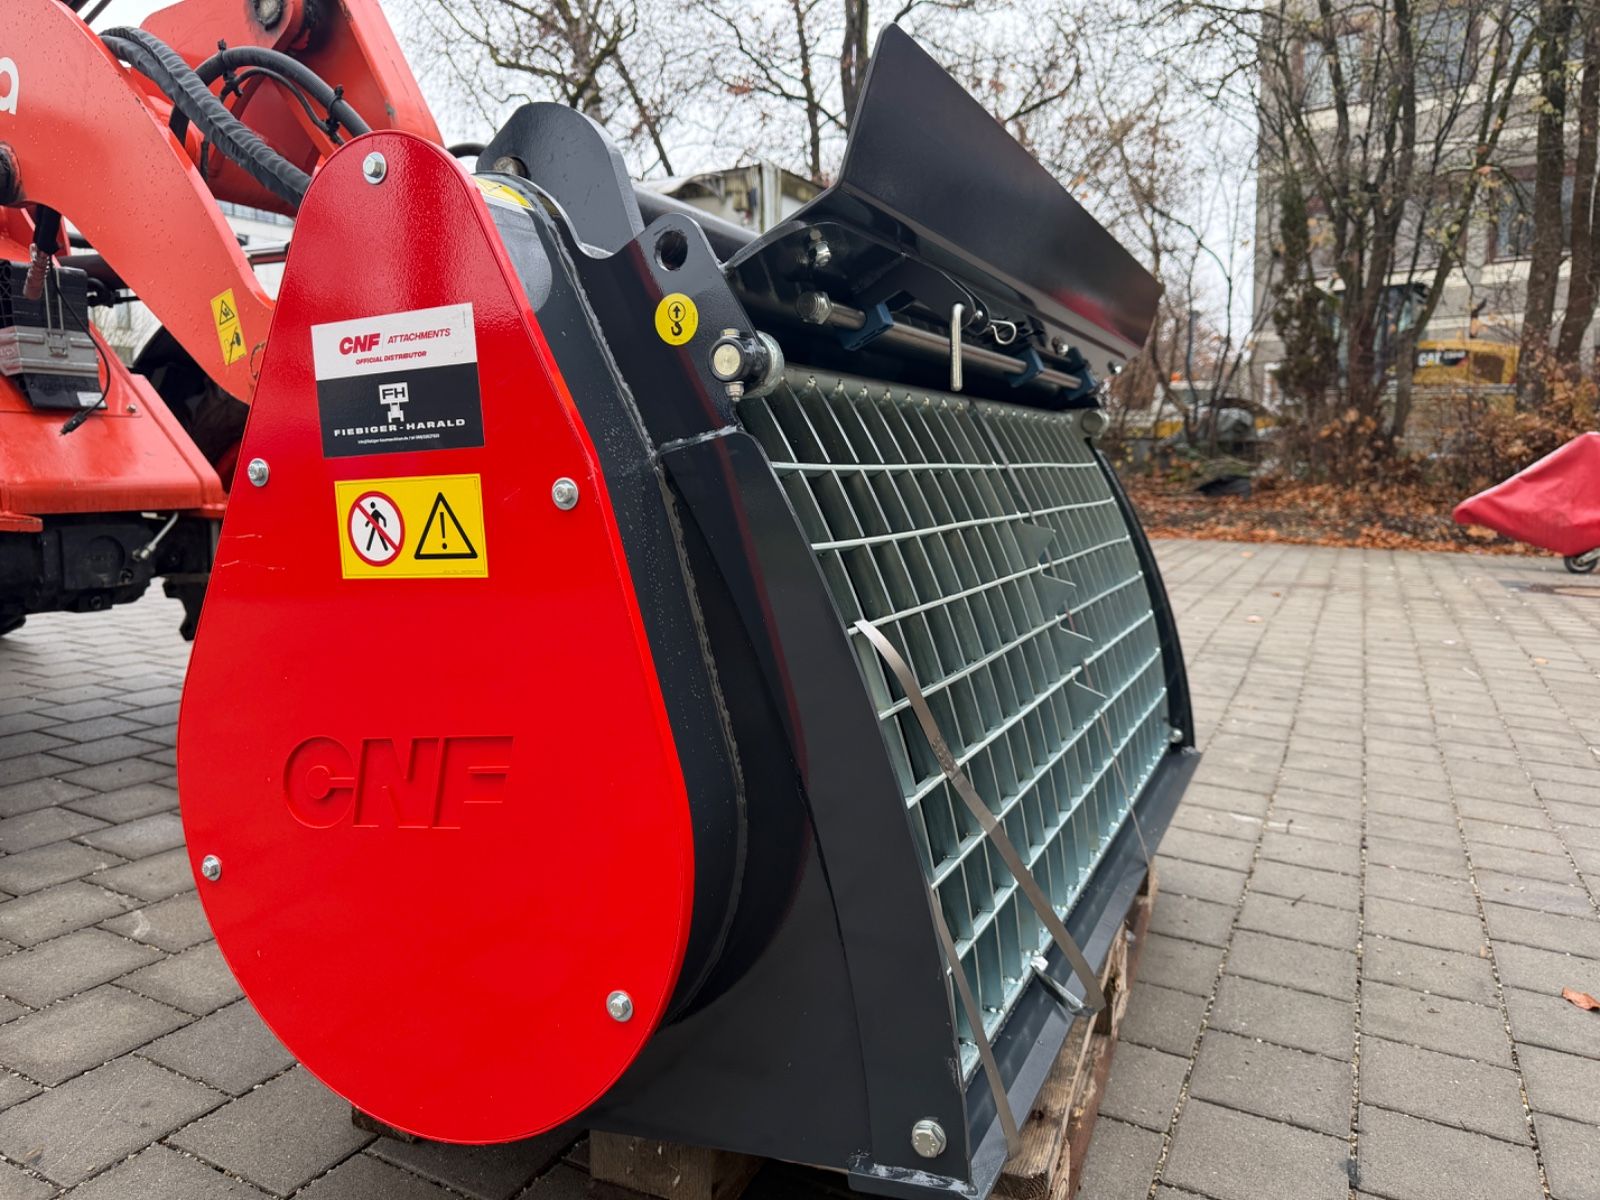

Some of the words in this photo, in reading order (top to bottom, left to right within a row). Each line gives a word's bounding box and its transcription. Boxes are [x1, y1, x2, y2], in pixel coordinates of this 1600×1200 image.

[339, 332, 381, 355] CNF
[387, 328, 451, 345] ATTACHMENTS
[355, 356, 383, 365] OFFICIAL
[384, 350, 427, 362] DISTRIBUTOR
[381, 387, 406, 400] FH
[283, 734, 514, 829] CNF
